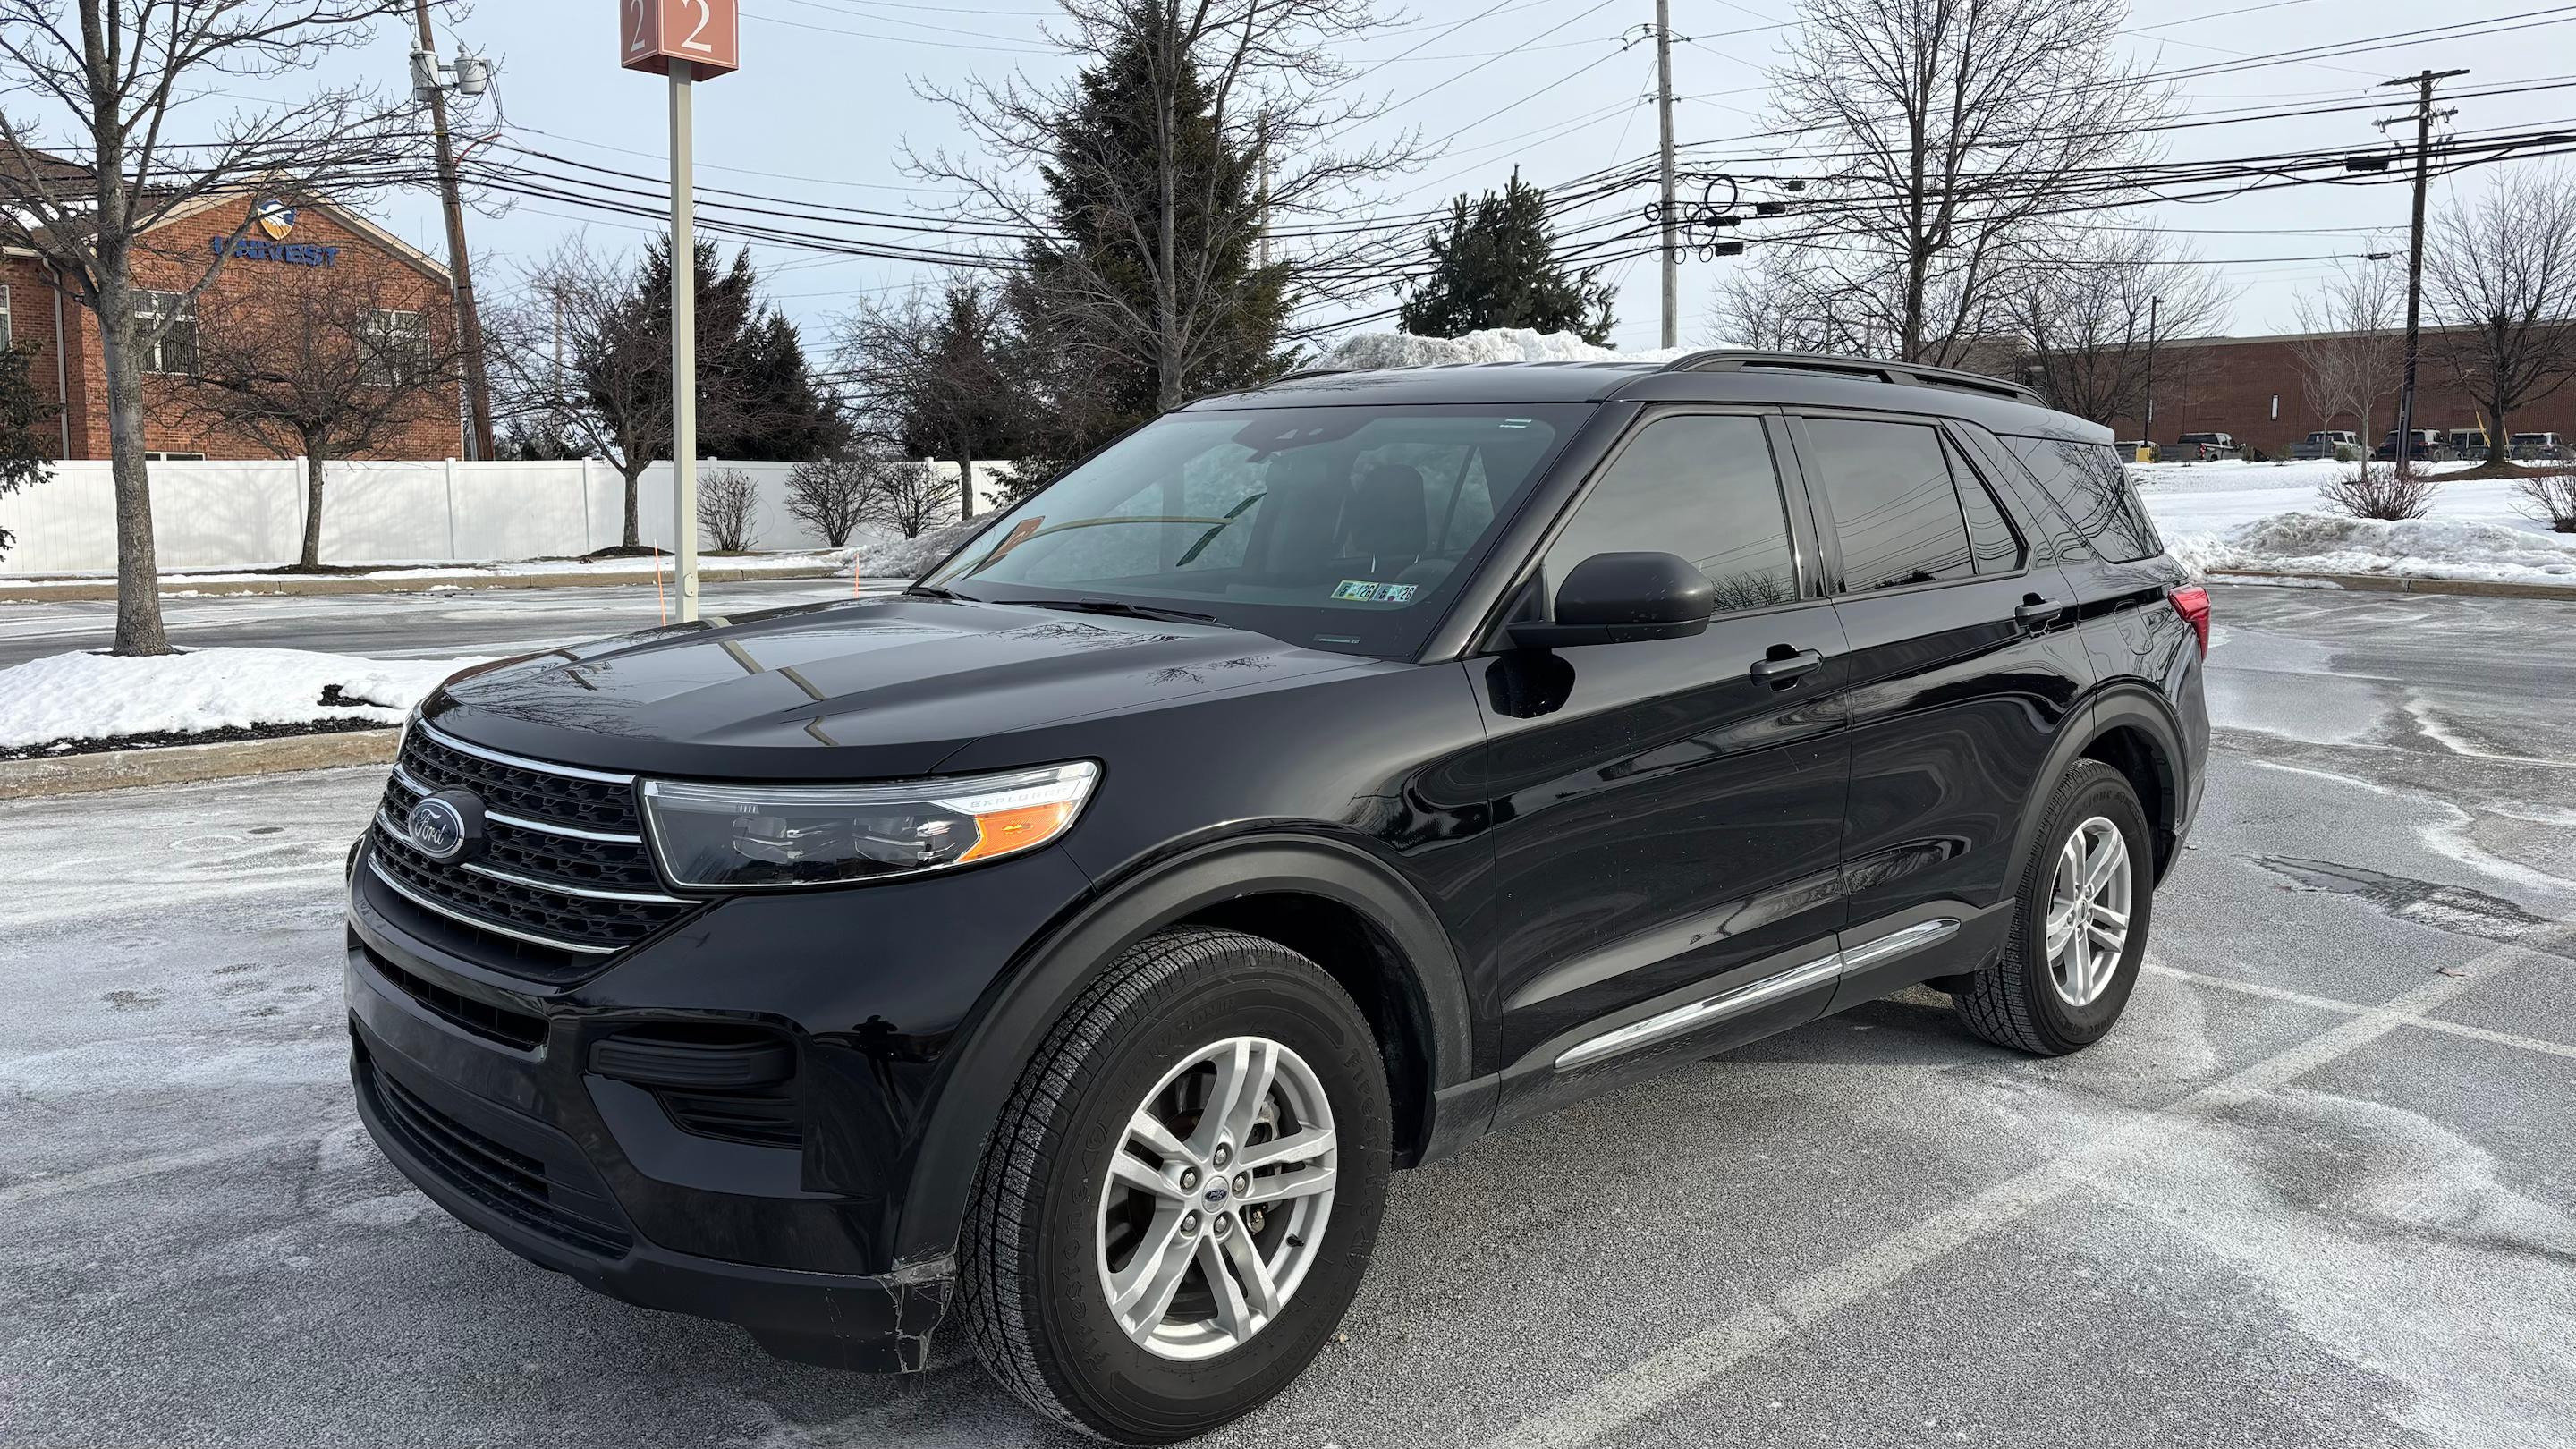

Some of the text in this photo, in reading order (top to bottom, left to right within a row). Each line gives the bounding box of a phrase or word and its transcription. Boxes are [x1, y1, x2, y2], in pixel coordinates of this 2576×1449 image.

[631, 0, 645, 52] 2
[681, 0, 712, 53] 2
[1378, 586, 1388, 599] 5
[415, 809, 446, 845] Ford
[1062, 1177, 1111, 1373] Firestone
